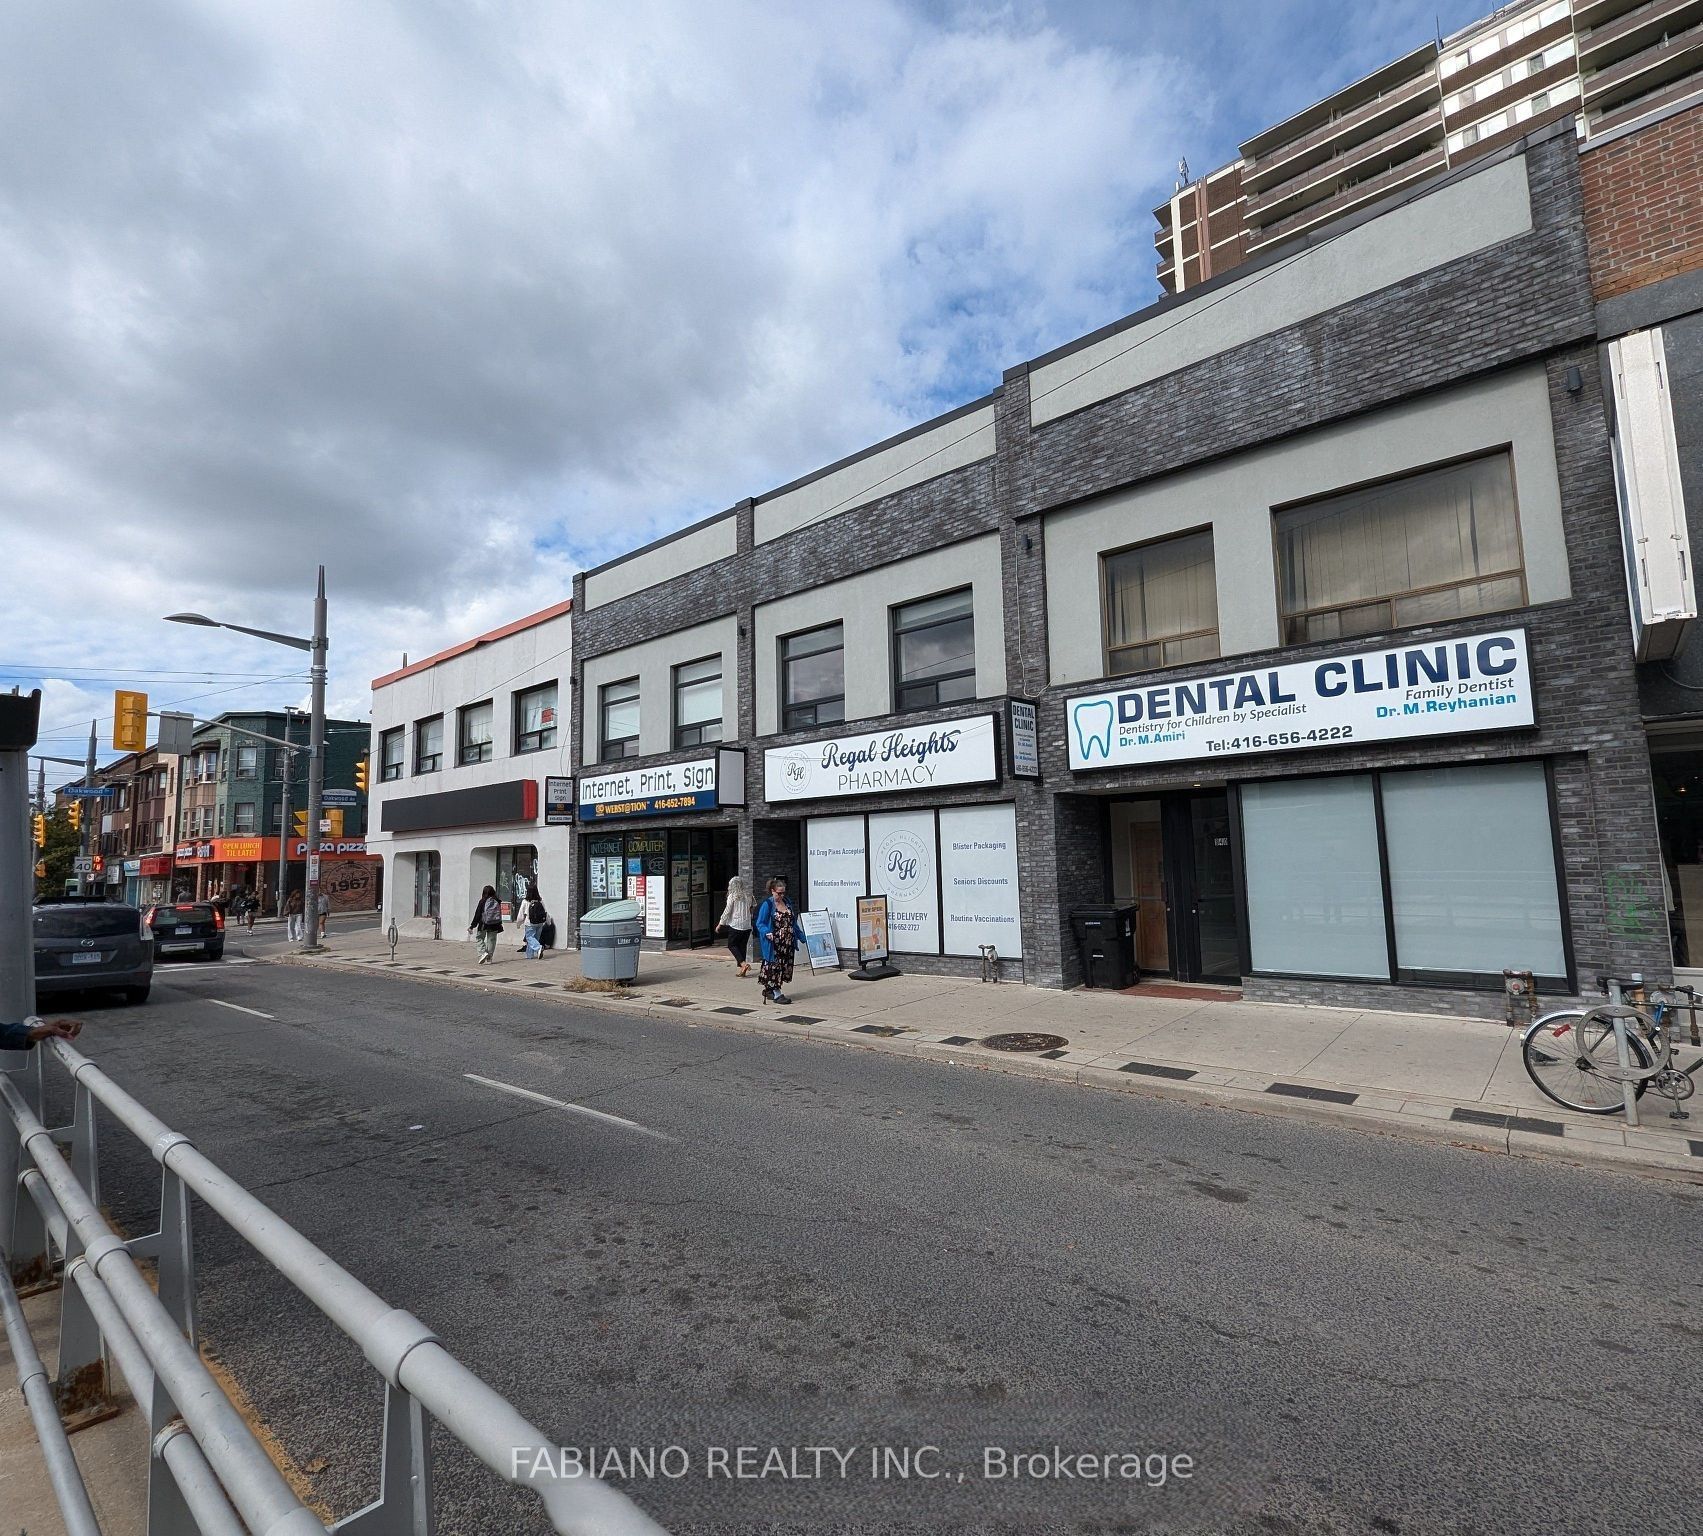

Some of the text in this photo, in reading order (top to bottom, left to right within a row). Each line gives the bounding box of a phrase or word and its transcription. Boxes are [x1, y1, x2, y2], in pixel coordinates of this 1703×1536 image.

[1117, 636, 1518, 724] DENTAL CLINIC
[1405, 677, 1514, 700] Family Dentist
[1012, 704, 1035, 719] DENTAL
[1376, 693, 1517, 718] Dr. M.Reyhanian
[1014, 718, 1034, 731] CLINIC
[1119, 703, 1307, 735] Dentistry for Children by Specialist
[1119, 730, 1185, 747] Dr. M.Amiri
[1206, 725, 1353, 752] Tel:416-656-4222
[821, 729, 962, 771] Regal Heights
[582, 766, 714, 800] Internet, Print, Sign
[838, 764, 937, 791] PHARMACY
[67, 787, 103, 795] Oakwood
[605, 801, 647, 814] WEBST@TION
[654, 796, 696, 809] 416-652-7894
[222, 842, 239, 850] OPEN
[297, 843, 335, 855] pza
[952, 842, 1007, 850] Blister Packaging
[76, 863, 91, 871] 40
[330, 877, 370, 893] 1967
[977, 877, 1009, 885] Discounts
[896, 912, 928, 921] DELIVERY
[950, 914, 1015, 923] Routine Vaccinations
